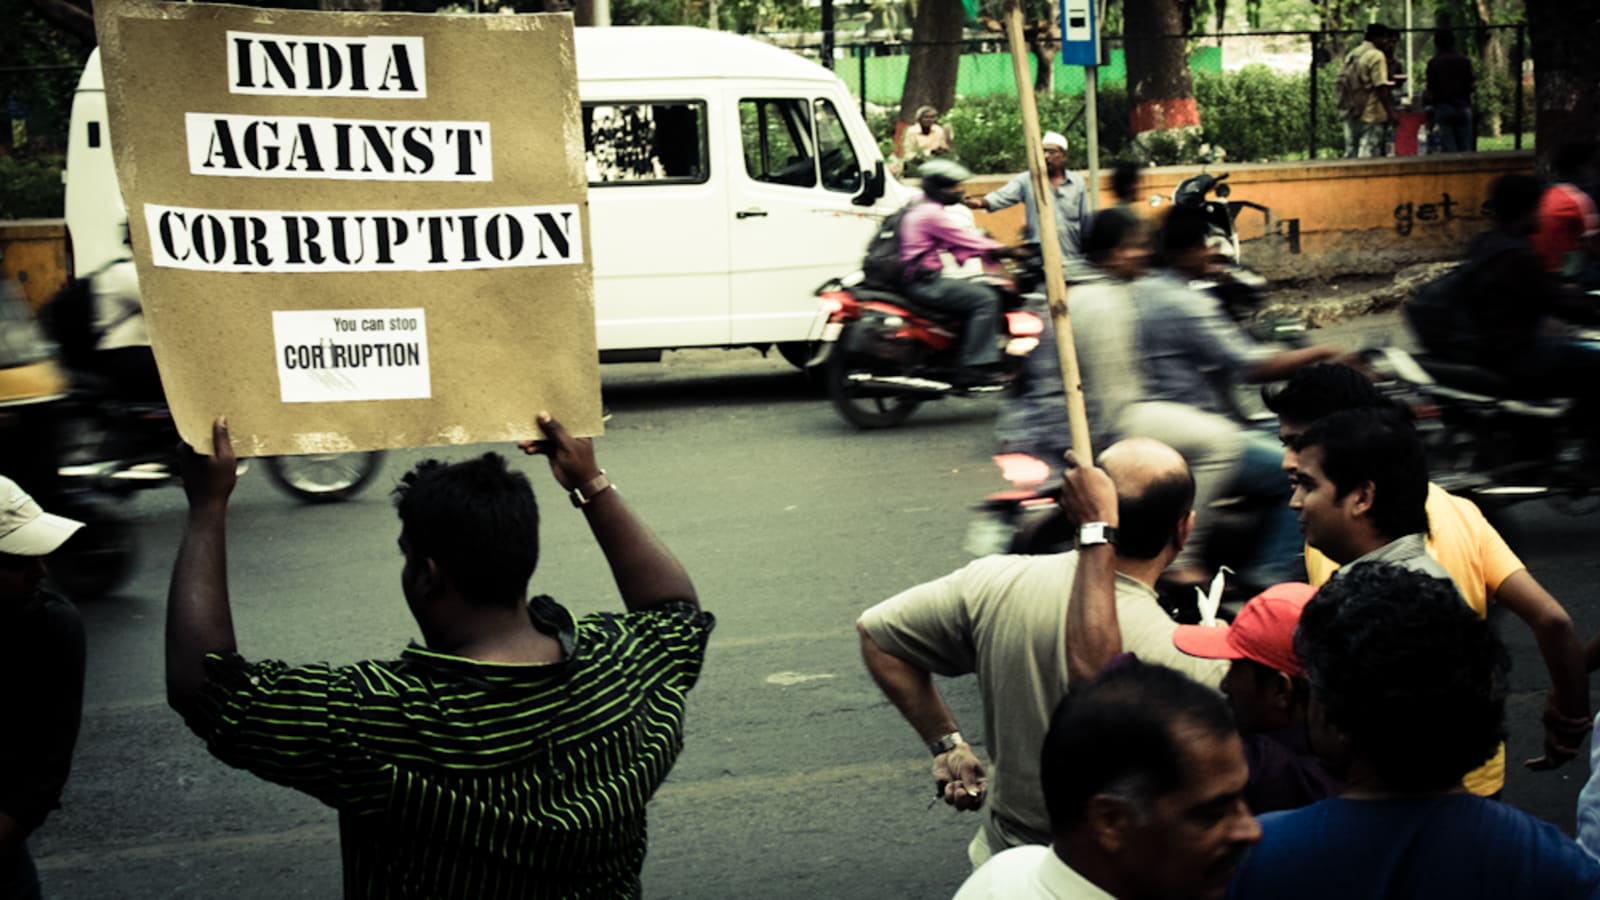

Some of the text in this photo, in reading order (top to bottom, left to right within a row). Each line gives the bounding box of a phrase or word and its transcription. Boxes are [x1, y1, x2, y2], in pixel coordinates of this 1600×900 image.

[233, 38, 418, 91] INDIA
[203, 119, 483, 176] AGAINST
[1394, 192, 1458, 236] get
[159, 211, 573, 266] CORRUPTION
[333, 317, 417, 332] You can stop
[284, 342, 420, 369] CORRUPTION
